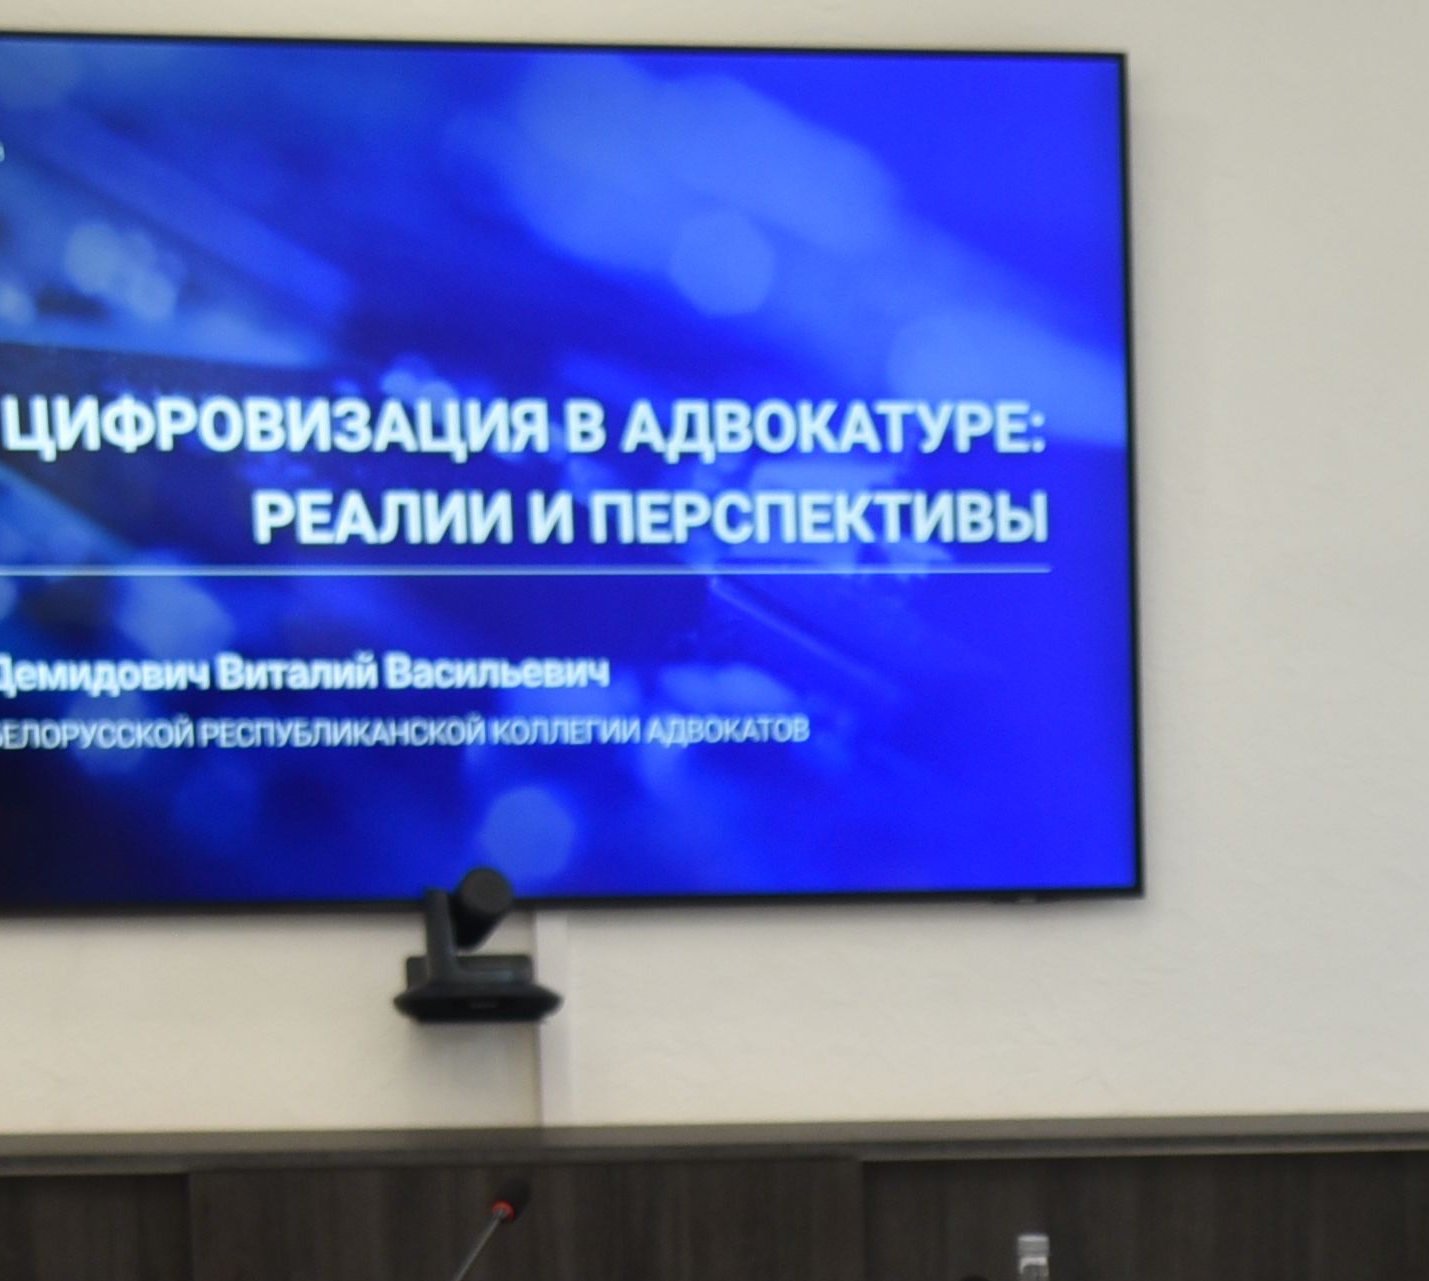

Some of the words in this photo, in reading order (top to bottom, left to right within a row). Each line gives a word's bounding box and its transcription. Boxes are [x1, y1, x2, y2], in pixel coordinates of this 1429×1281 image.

[0, 394, 550, 463] ЦИФРОВИЗАЦИЯ
[564, 398, 607, 454] В
[619, 397, 1048, 464] АДВОКАТУРЕ:
[252, 488, 515, 545] РЕАЛИИ
[527, 489, 574, 545] И
[588, 490, 1049, 545] ПЕРСПЕКТИВЫ
[215, 648, 378, 692] Виталий
[383, 652, 611, 690] Васильевич
[199, 712, 486, 750] РЕСПУБЛИКАНСКОЙ
[491, 718, 641, 746] КОЛЛЕГИИ
[644, 715, 811, 750] АДВОКАТОВ
